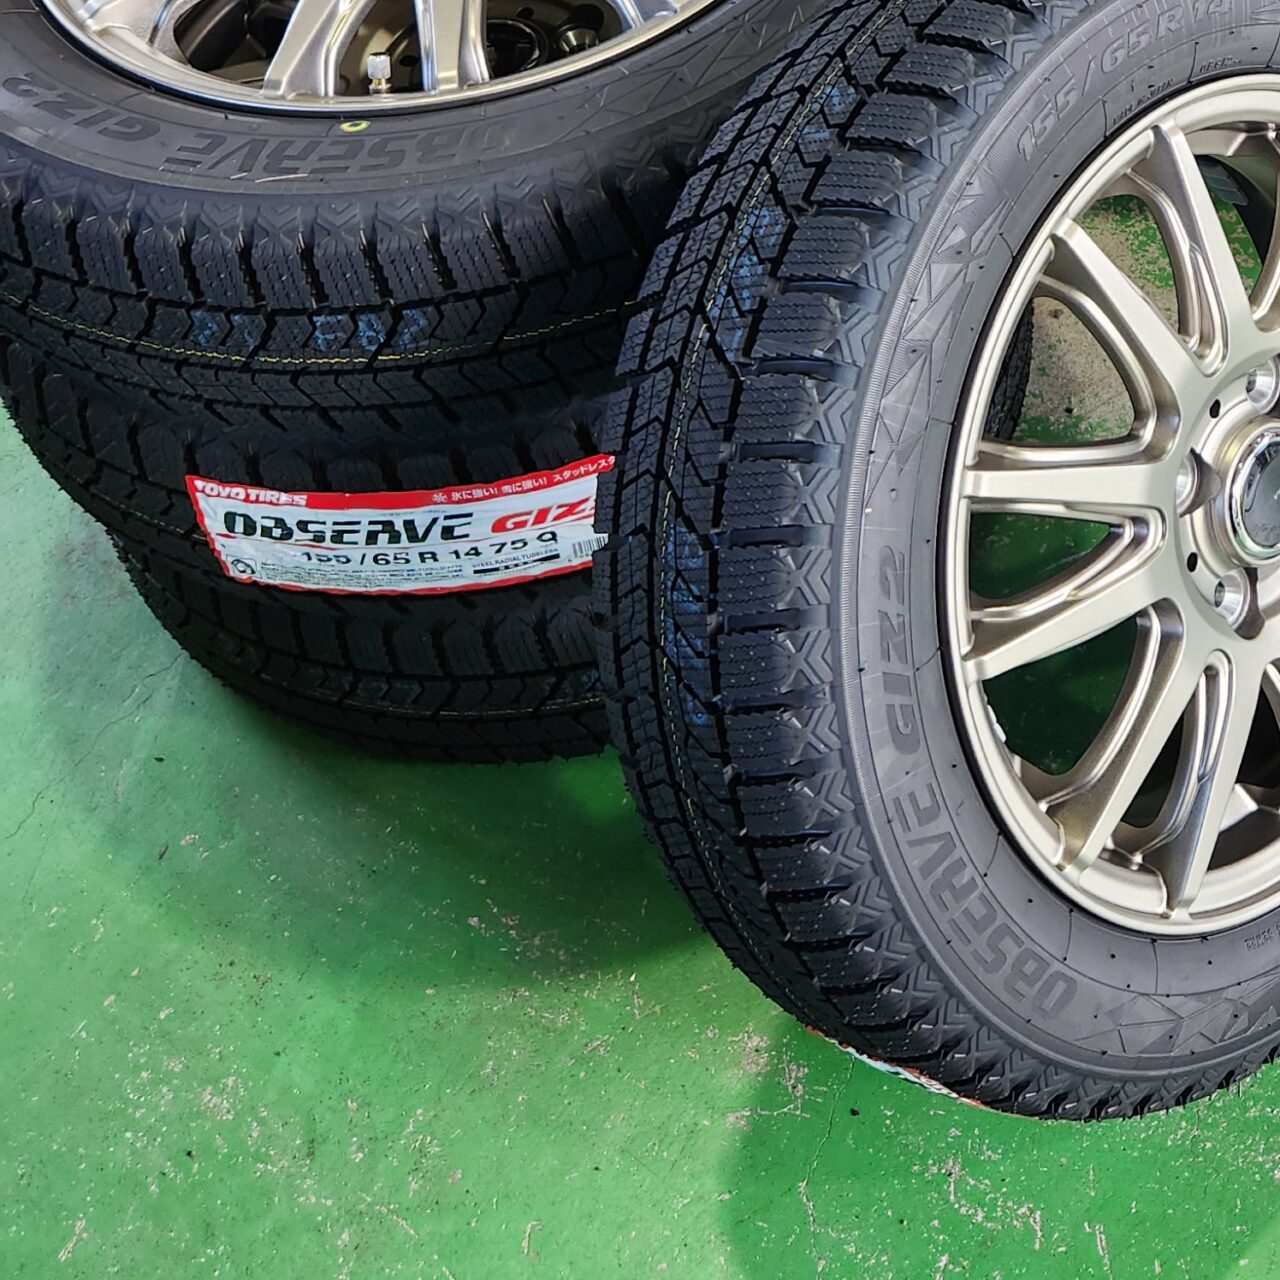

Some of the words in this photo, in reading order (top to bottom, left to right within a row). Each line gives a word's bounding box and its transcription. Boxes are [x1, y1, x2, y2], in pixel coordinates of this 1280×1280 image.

[194, 479, 247, 503] TOYO
[247, 487, 309, 507] TIRES
[223, 510, 474, 546] OBSERVE
[490, 495, 596, 534] GIZ
[418, 550, 439, 565] R
[448, 545, 483, 561] 14
[488, 537, 529, 556] 75
[536, 530, 559, 545] Q
[878, 544, 922, 757] GIZ2
[892, 781, 1078, 1018] OBSERVE
